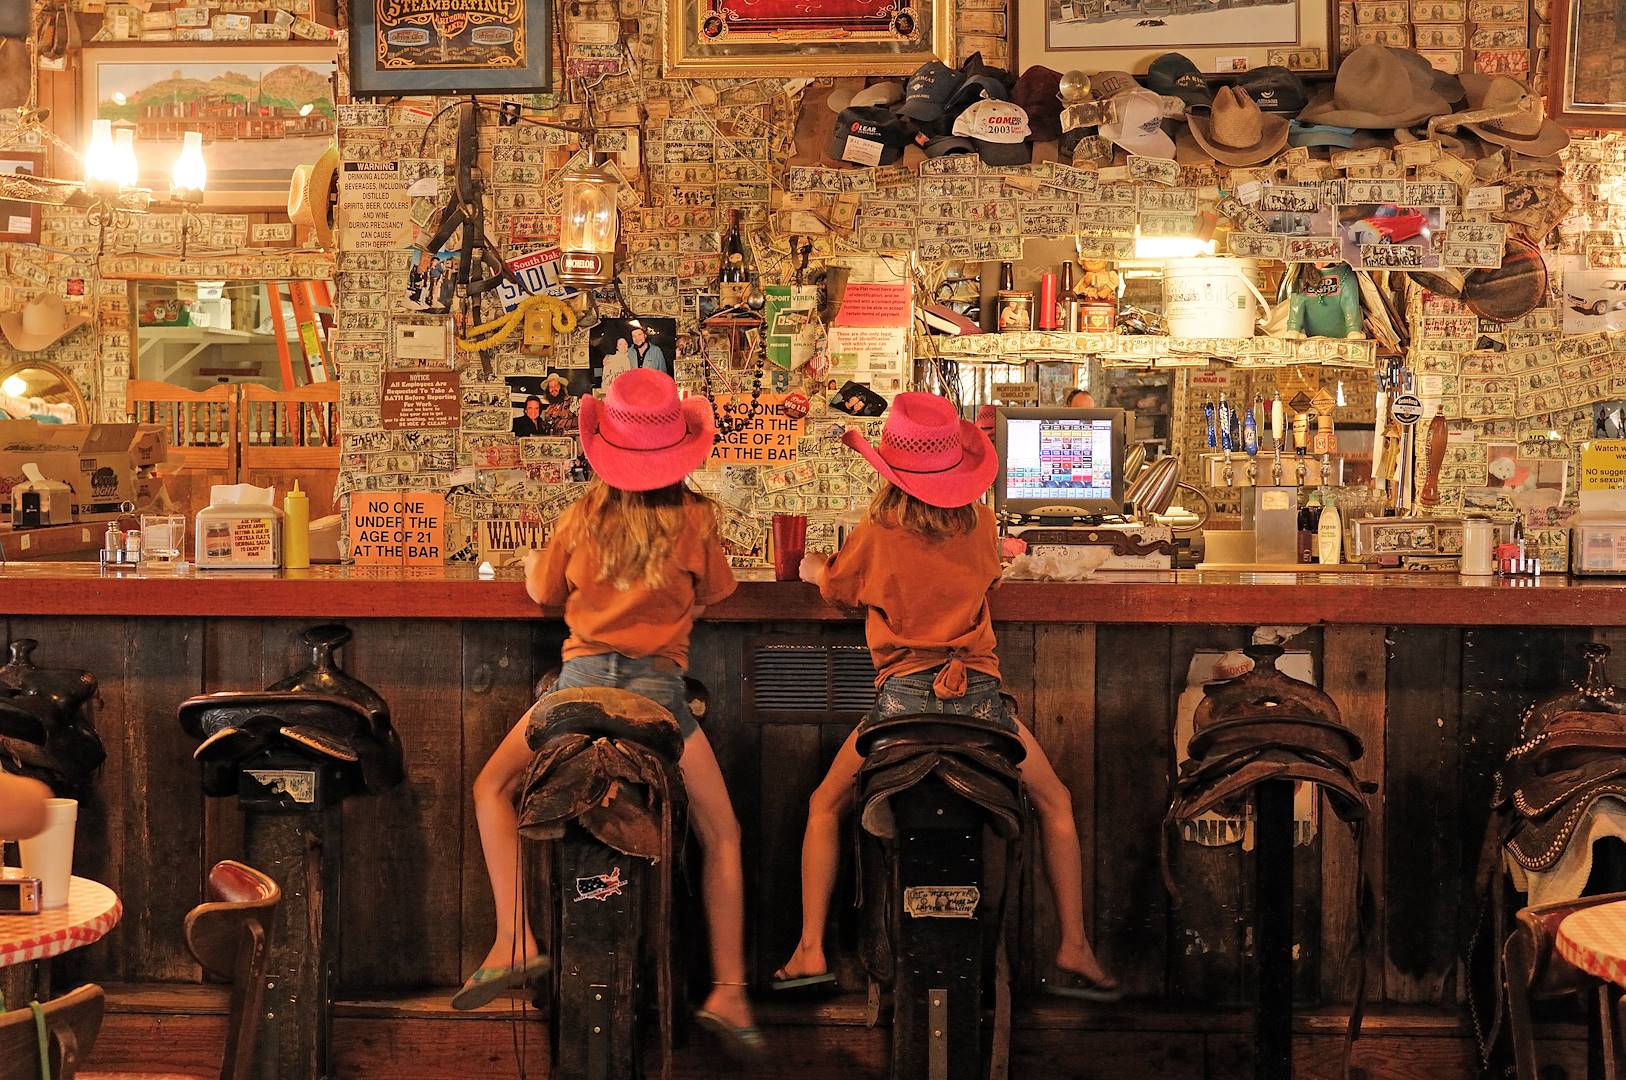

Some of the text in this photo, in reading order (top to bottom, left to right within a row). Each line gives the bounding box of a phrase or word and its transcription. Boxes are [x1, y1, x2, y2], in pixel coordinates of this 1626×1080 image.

[988, 125, 1010, 134] 2003
[357, 162, 394, 171] WARNING
[347, 173, 372, 181] DRINKING
[379, 182, 409, 190] INCLUDING
[363, 192, 390, 200] DISTILLED
[383, 202, 409, 210] COOLERS
[360, 231, 392, 239] CAN CAUSE
[355, 241, 372, 249] BIRTH
[513, 250, 560, 271] South Dak
[565, 259, 595, 269] MICHELOB
[754, 403, 785, 416] ONE
[768, 418, 798, 431] THE
[718, 432, 792, 446] AGE OF 21
[711, 446, 730, 459] AT
[733, 447, 763, 460] THE
[1585, 468, 1598, 476] NO
[1599, 476, 1625, 484] sexual
[81, 505, 91, 513] 24
[368, 501, 424, 513] NO ONE
[355, 516, 437, 528] UNDER THE
[359, 530, 431, 543] AGE OF 21
[486, 521, 555, 549] WANTE
[353, 545, 438, 558] AT THE BAR
